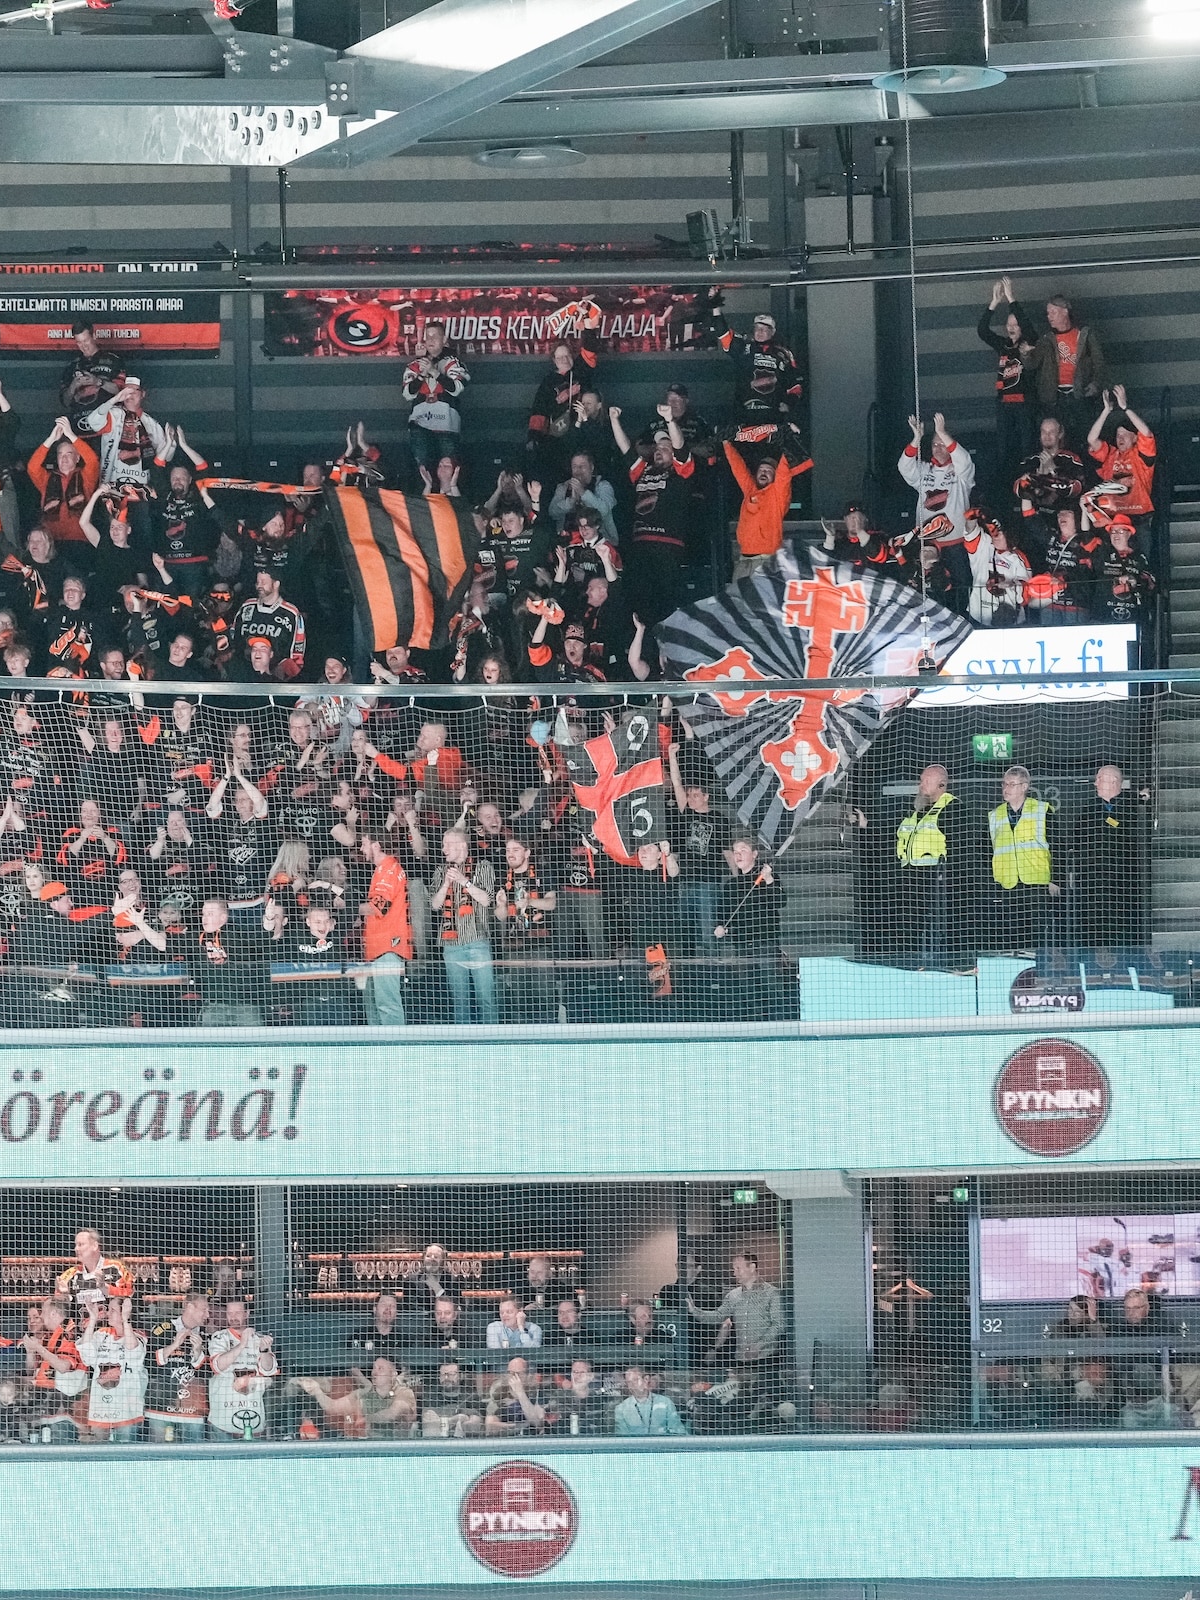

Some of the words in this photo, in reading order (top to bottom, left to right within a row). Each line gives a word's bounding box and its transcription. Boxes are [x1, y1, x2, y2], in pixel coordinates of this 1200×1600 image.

[70, 298, 108, 311] IHMISEN
[111, 298, 153, 311] PARASTA
[156, 298, 183, 311] AIKAA
[113, 329, 140, 339] TUKENA
[424, 315, 501, 340] UUDES
[982, 1318, 1003, 1333] 32
